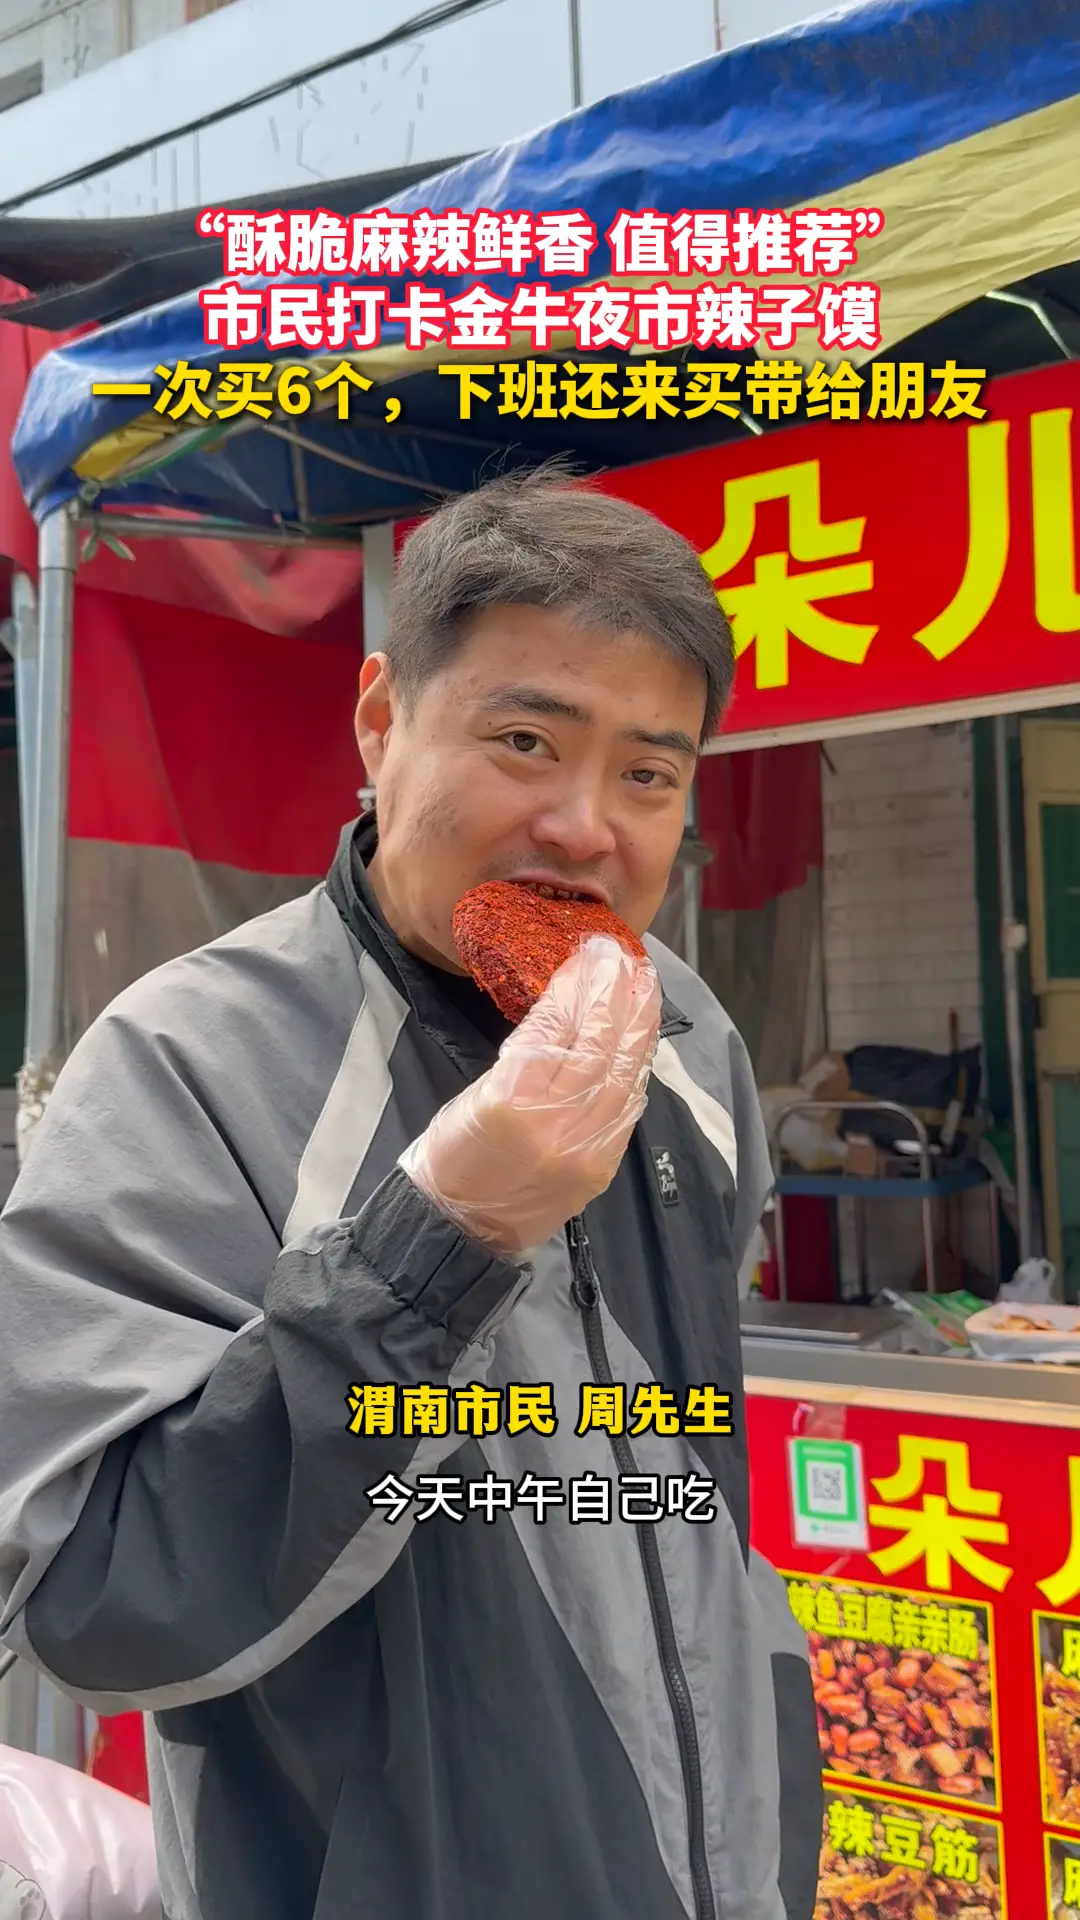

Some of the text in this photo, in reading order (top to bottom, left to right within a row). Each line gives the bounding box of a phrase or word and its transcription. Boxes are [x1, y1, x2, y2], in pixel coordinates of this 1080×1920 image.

[699, 407, 1080, 691] 朵儿
[828, 1799, 980, 1883] 辣豆筋
